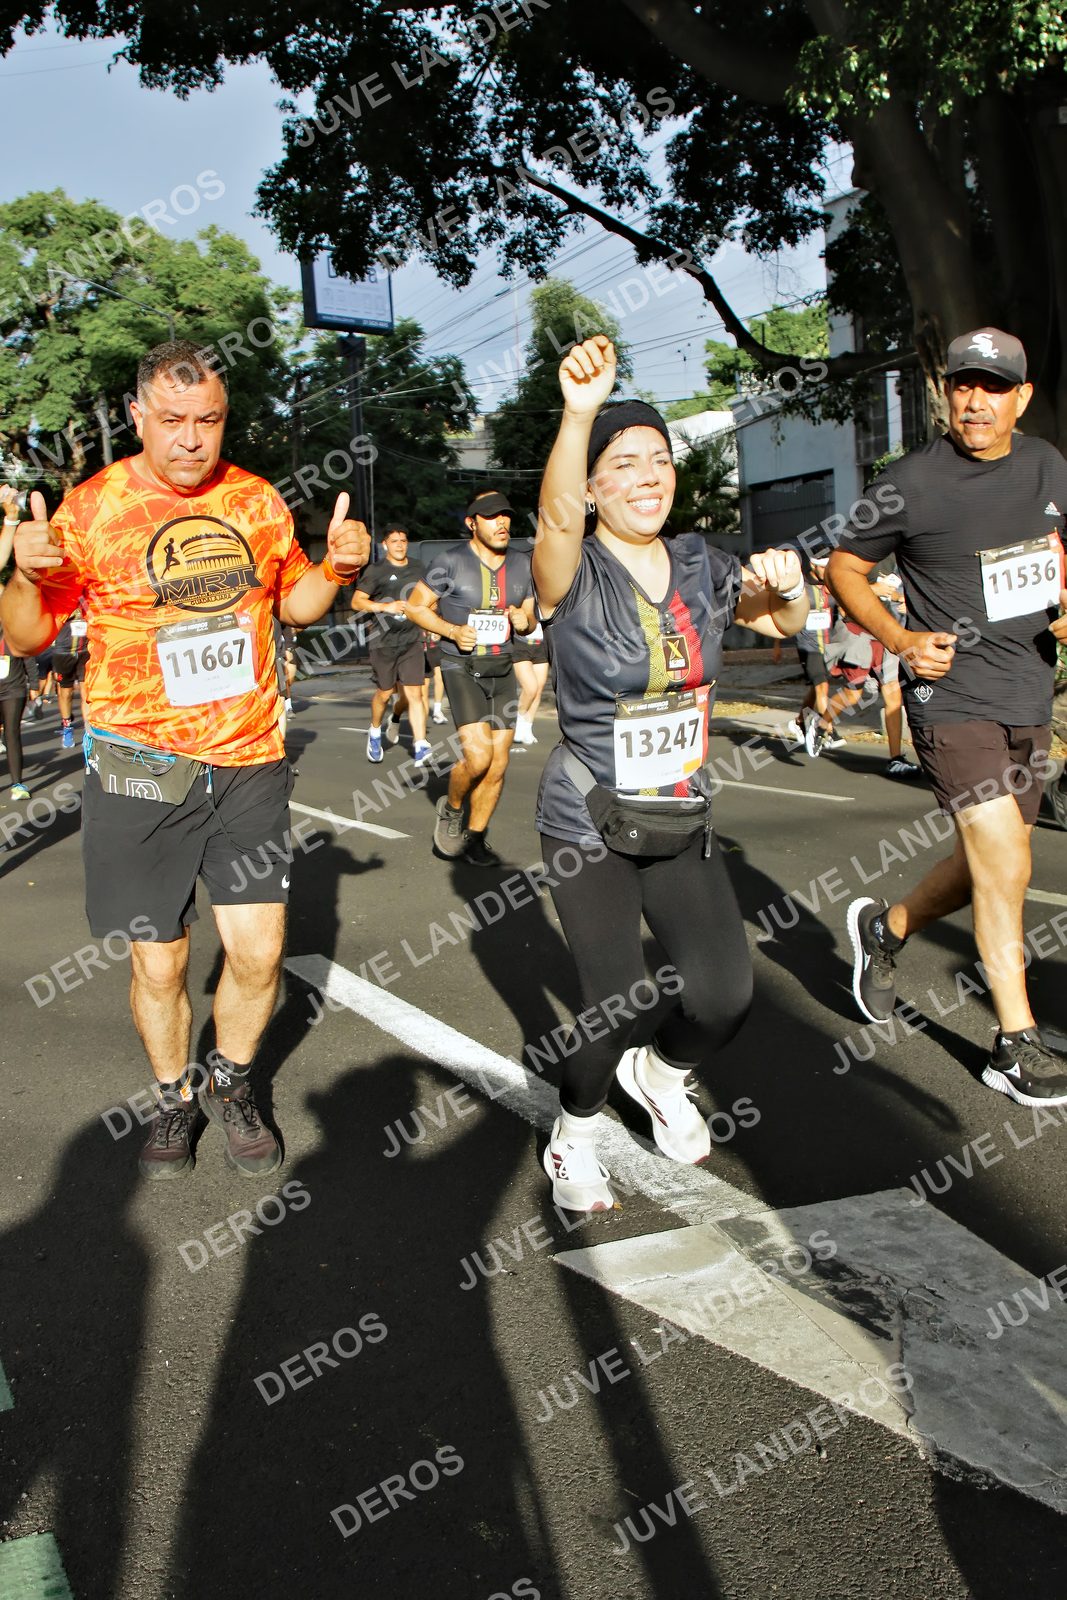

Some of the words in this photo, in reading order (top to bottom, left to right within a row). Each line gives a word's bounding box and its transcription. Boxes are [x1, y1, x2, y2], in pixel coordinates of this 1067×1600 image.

[159, 566, 253, 603] MRT
[989, 558, 1056, 594] 11536
[166, 638, 246, 678] 11667
[620, 717, 700, 758] 13247
